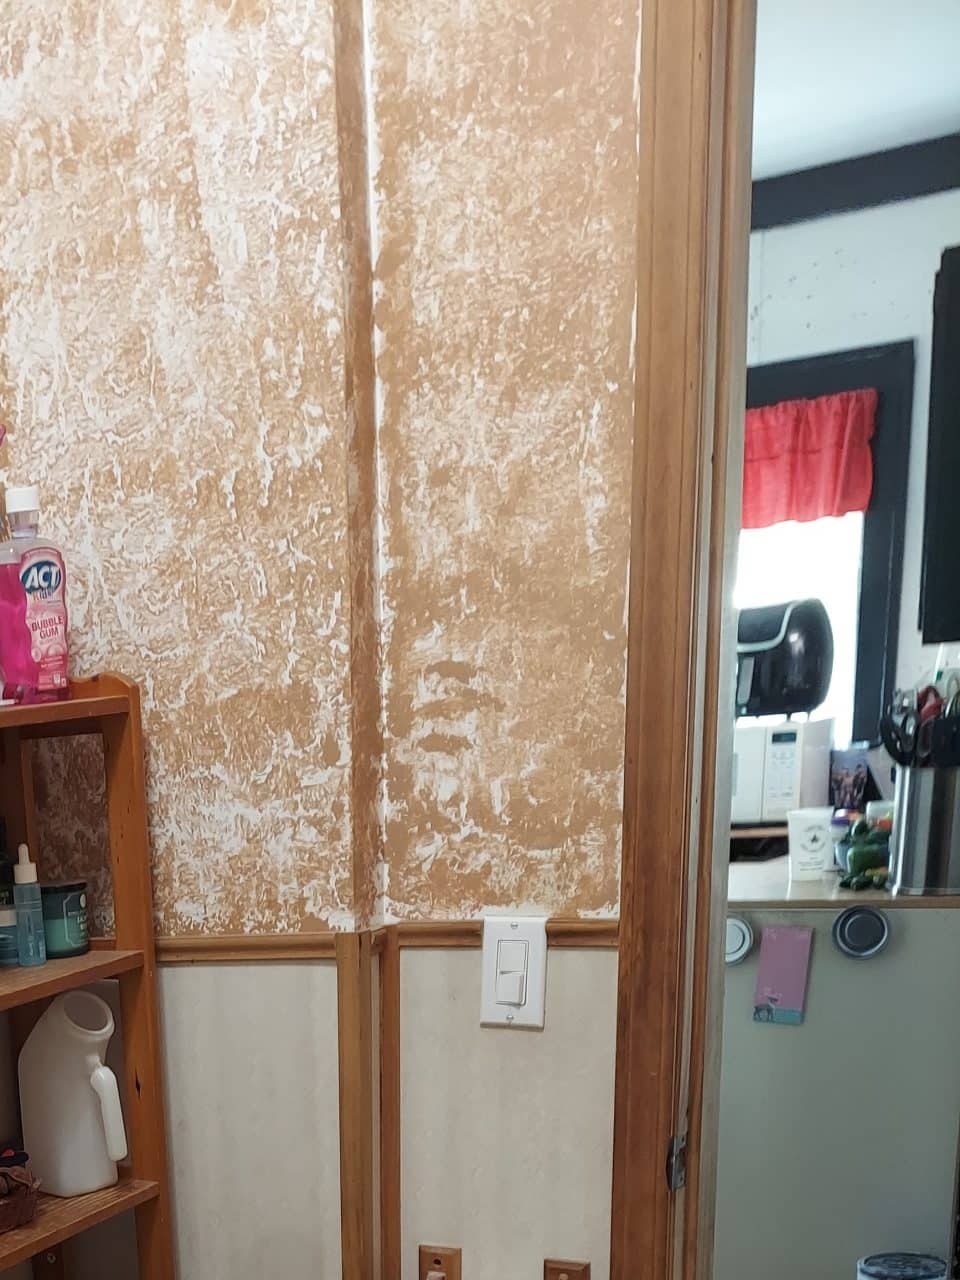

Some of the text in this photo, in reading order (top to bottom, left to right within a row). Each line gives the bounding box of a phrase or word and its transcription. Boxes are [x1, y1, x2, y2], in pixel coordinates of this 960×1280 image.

[25, 565, 60, 590] ACT
[31, 615, 63, 632] BUBBLE
[39, 626, 59, 639] GUM
